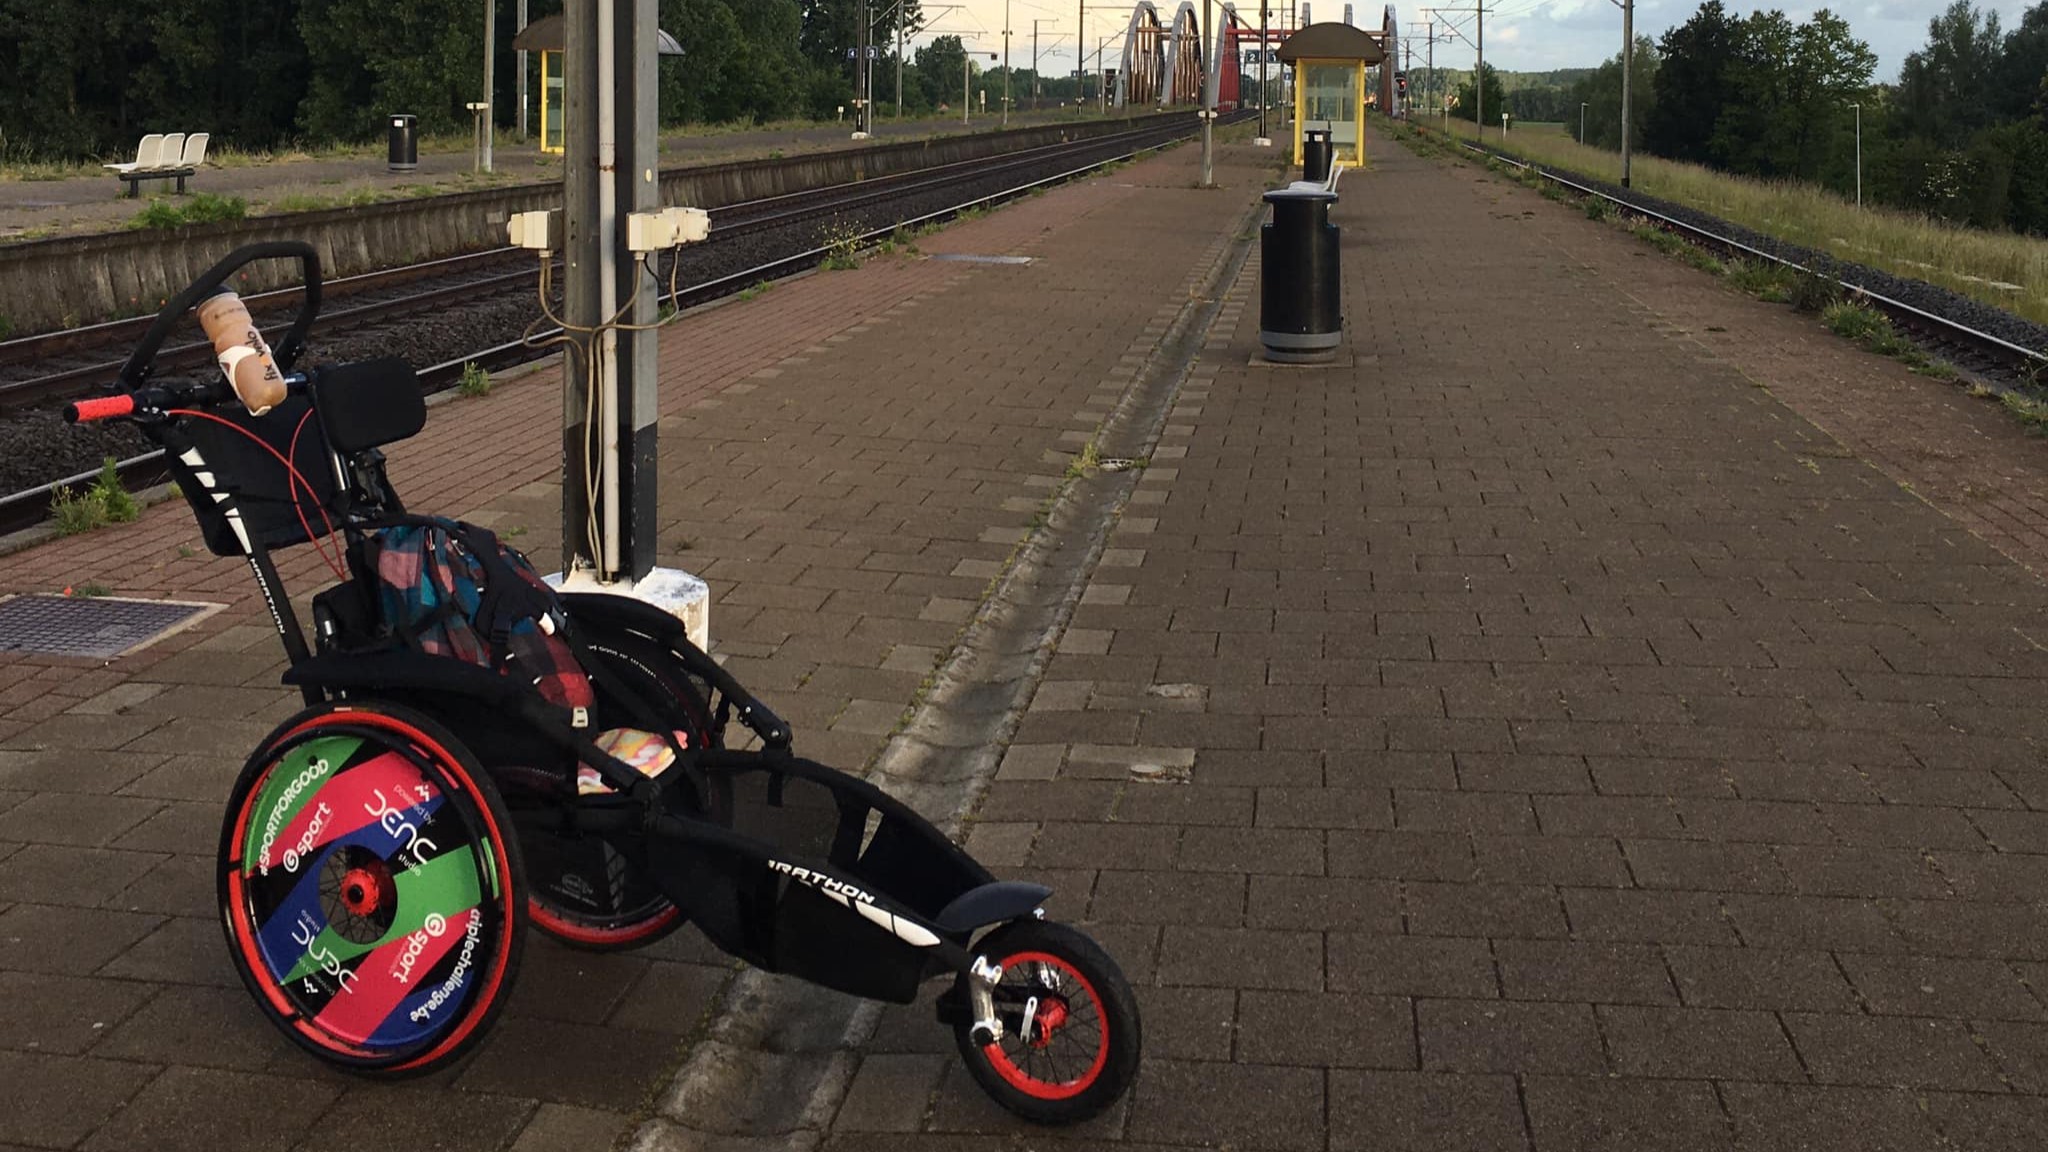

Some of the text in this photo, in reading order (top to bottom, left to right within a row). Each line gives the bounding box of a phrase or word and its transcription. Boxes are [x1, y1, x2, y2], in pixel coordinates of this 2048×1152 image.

[250, 558, 286, 634] MARATHON
[259, 759, 329, 877] #SPORTFORGOOD
[398, 854, 422, 877] studio
